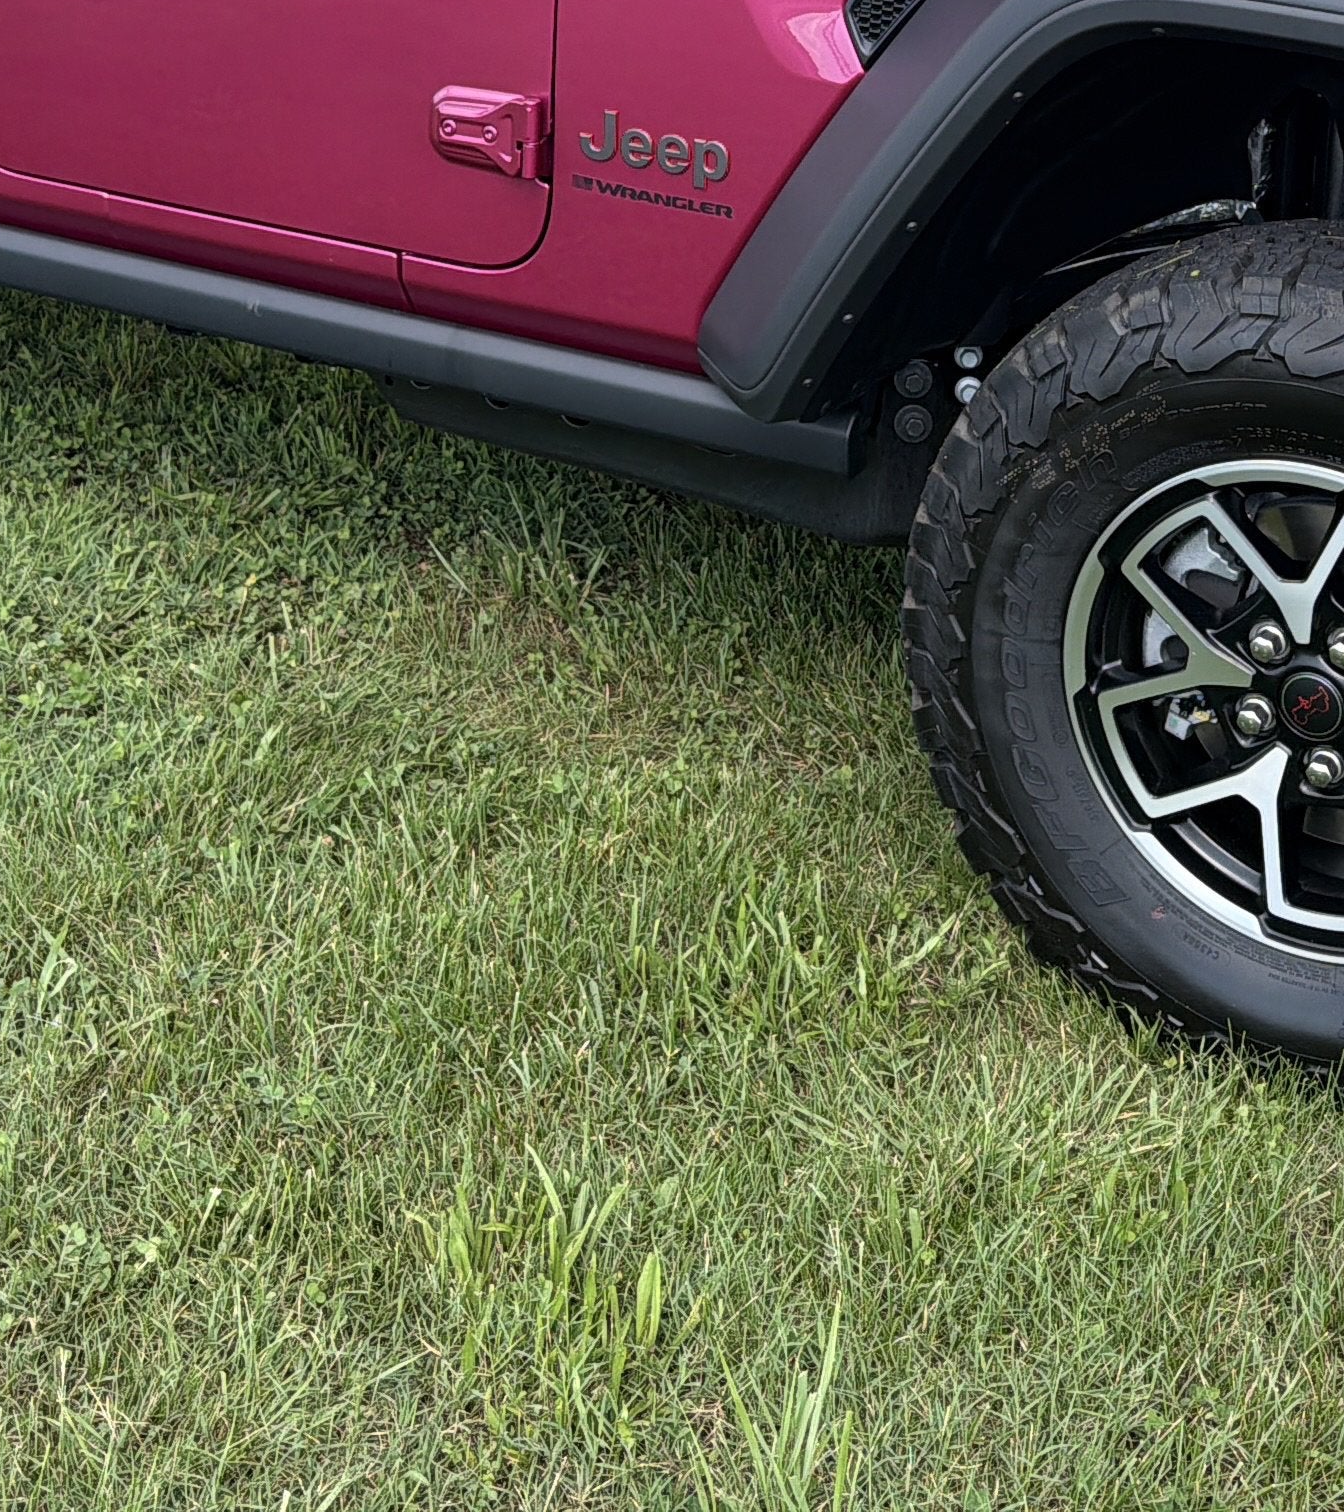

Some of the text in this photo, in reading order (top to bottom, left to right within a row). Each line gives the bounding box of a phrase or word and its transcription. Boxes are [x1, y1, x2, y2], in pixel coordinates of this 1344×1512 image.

[578, 108, 732, 191] Jeep
[594, 178, 734, 220] WRANGLER
[1000, 447, 1130, 908] BFGoodrich
